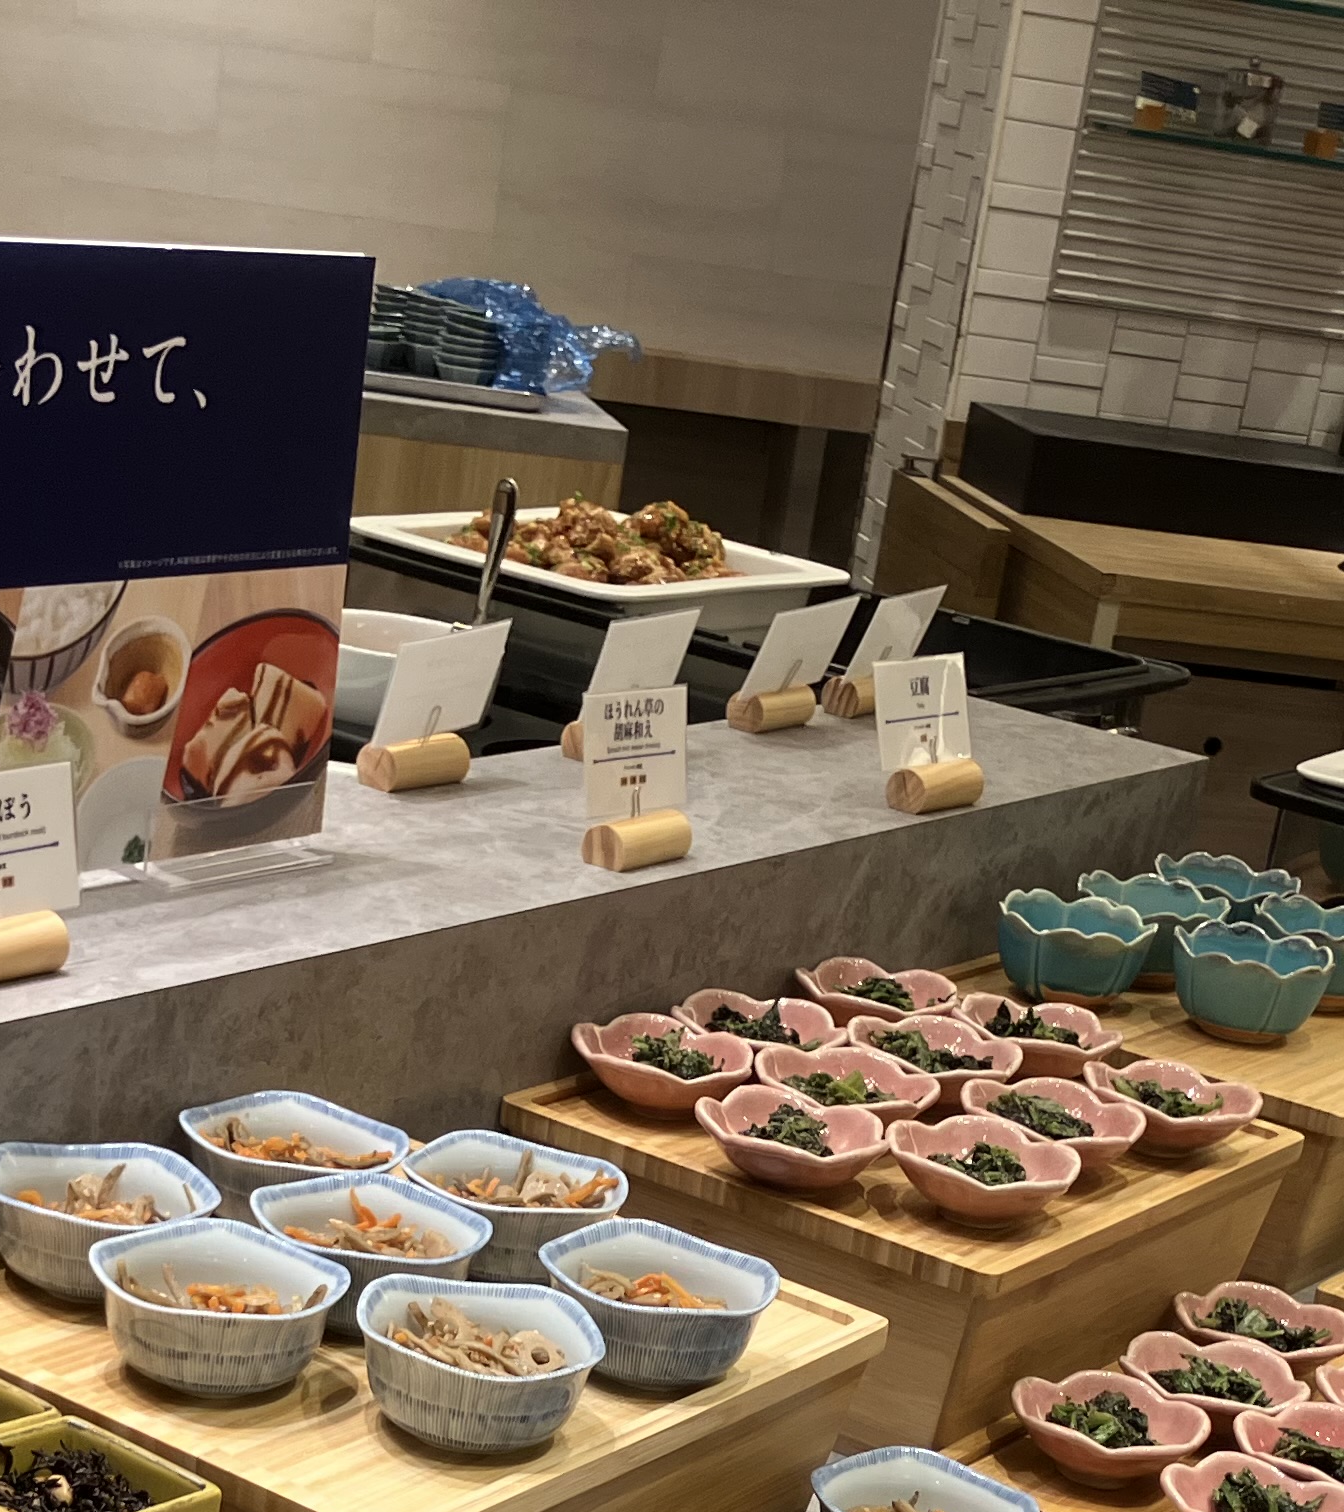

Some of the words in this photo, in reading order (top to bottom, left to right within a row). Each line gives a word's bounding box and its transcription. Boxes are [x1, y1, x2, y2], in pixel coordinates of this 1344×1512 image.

[604, 698, 665, 720] ほうれん草の
